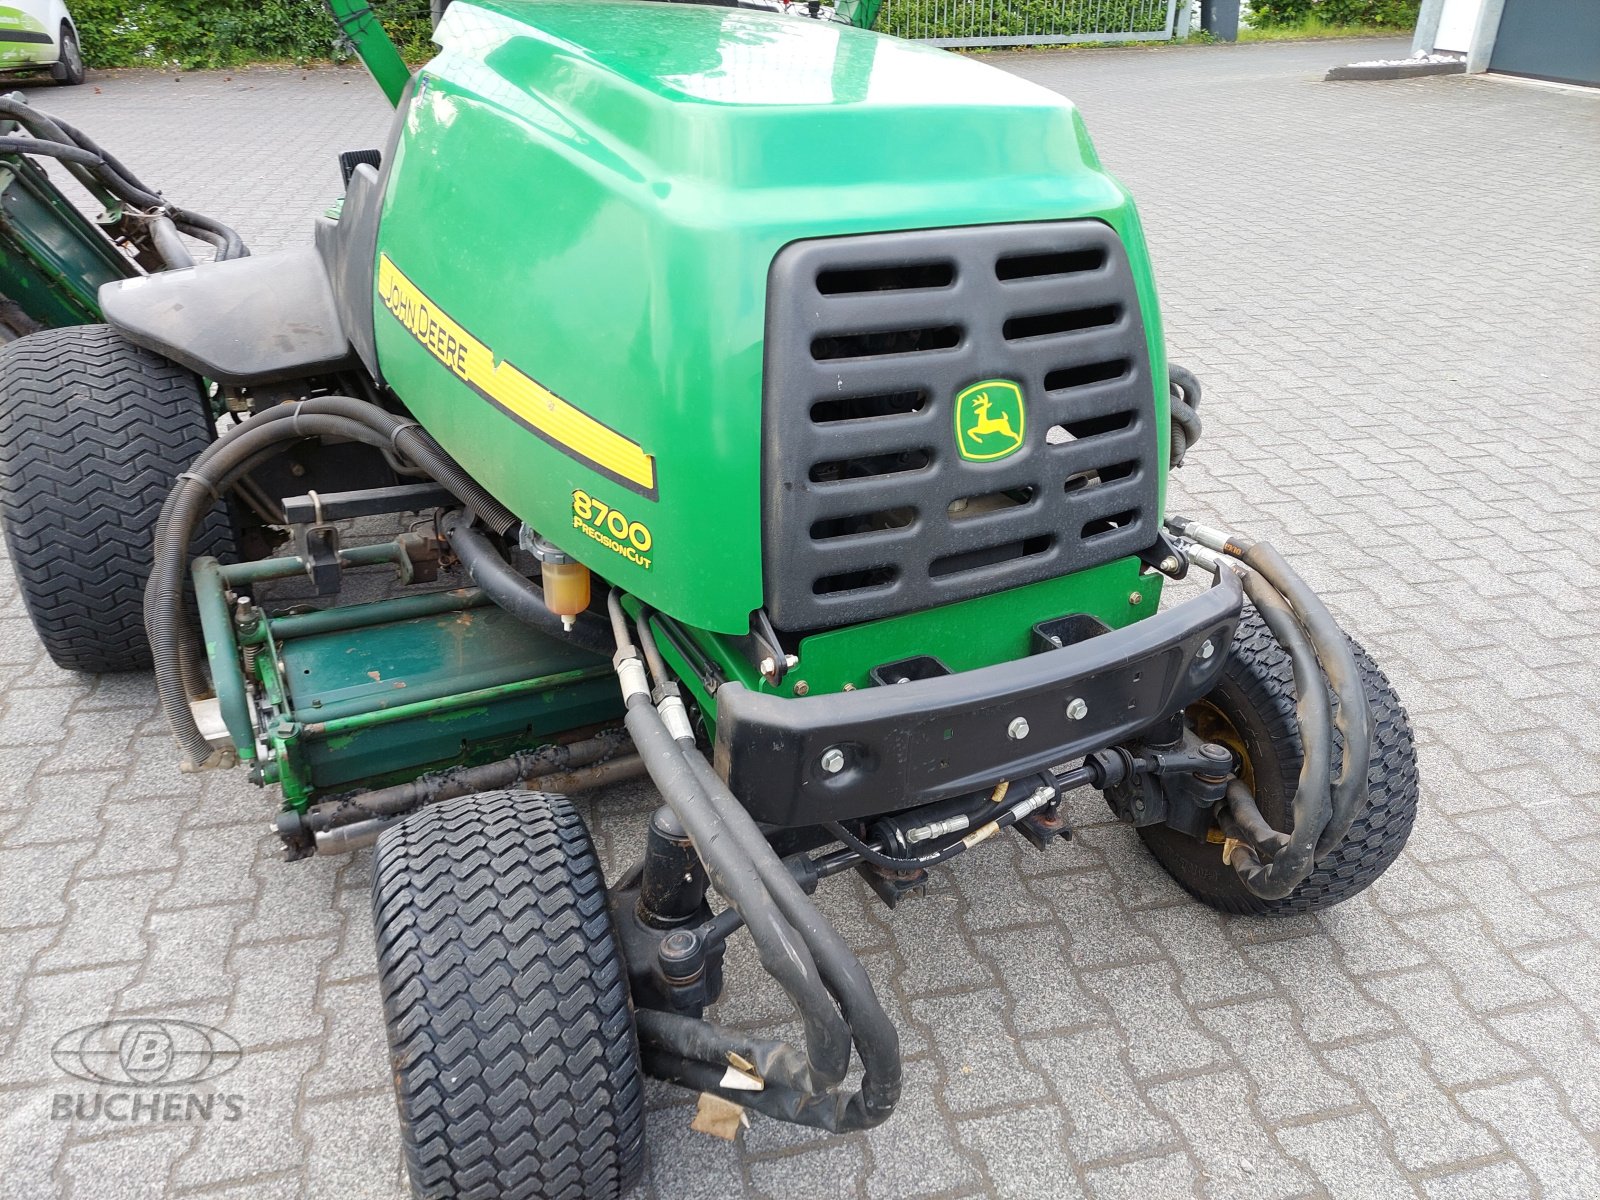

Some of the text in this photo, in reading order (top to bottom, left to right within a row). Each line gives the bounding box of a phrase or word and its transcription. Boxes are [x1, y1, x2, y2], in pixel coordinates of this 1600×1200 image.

[385, 275, 468, 374] JOHN DEERE
[572, 490, 652, 552] 8700
[573, 515, 652, 569] PRECISIONCUT
